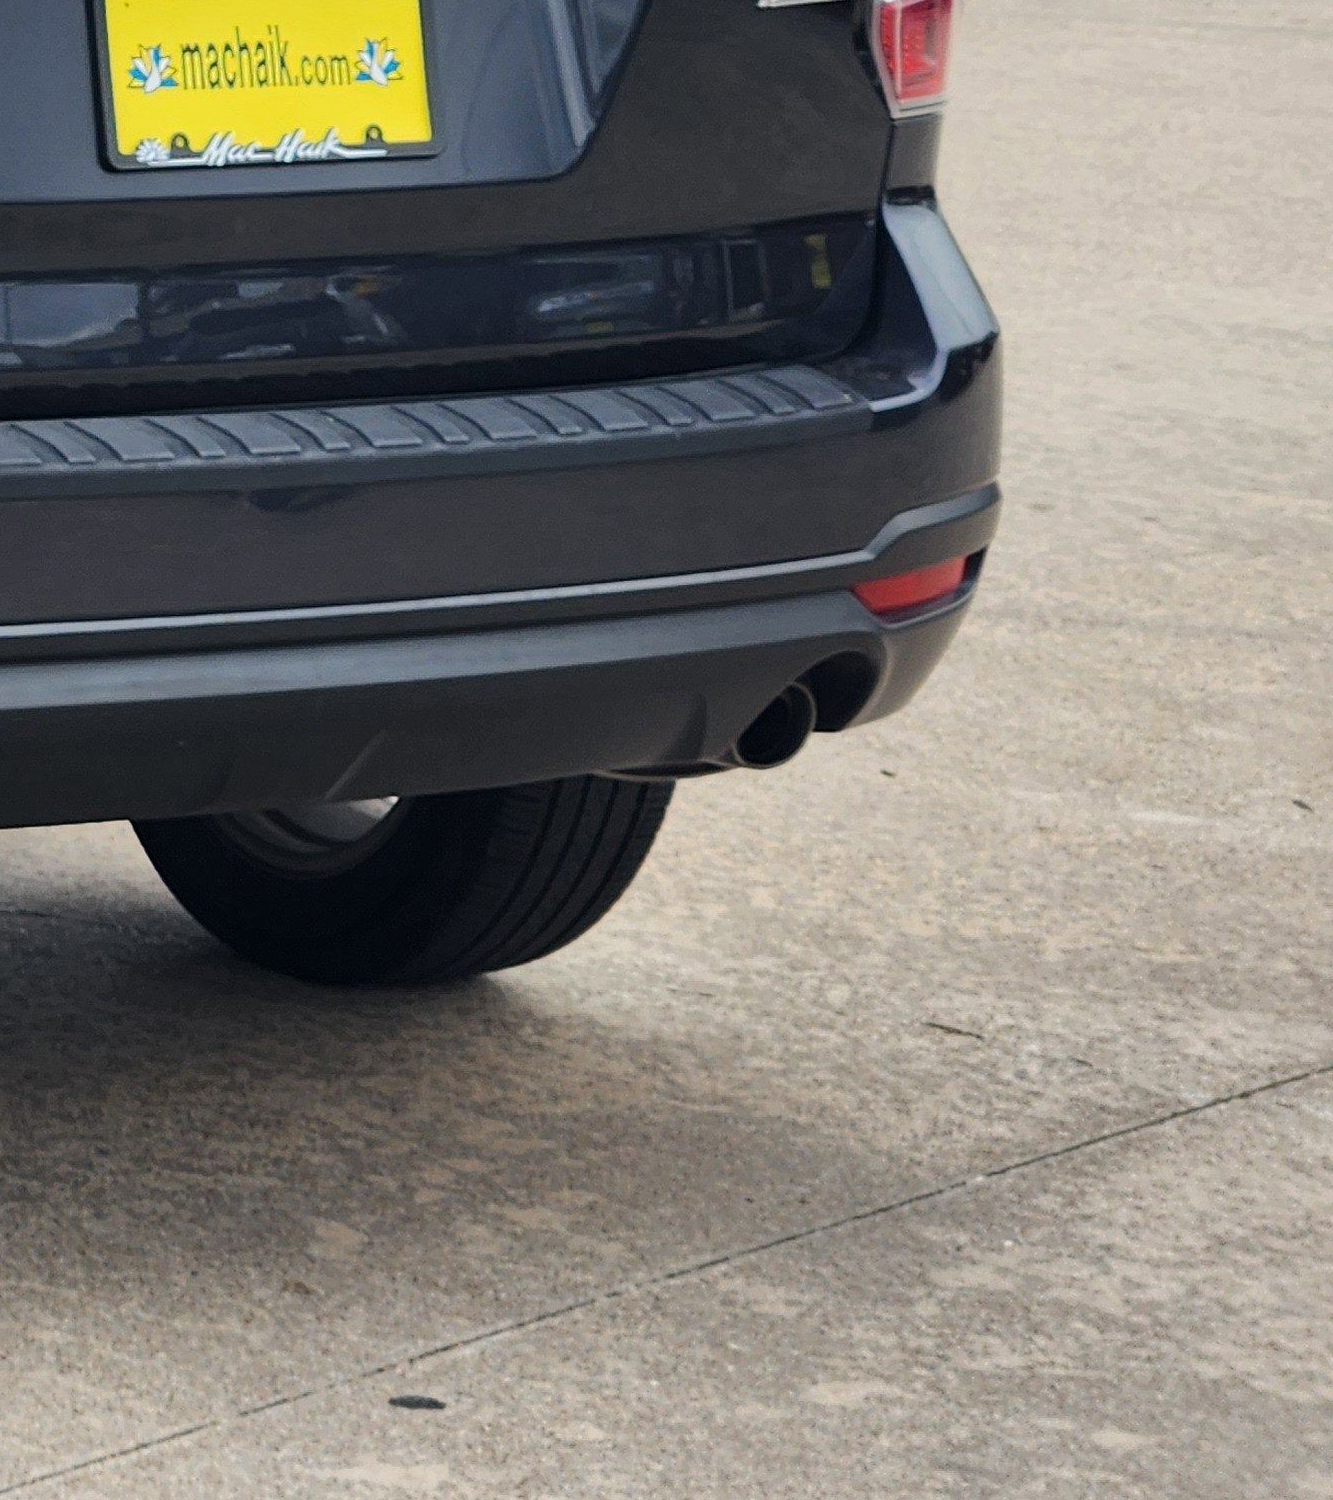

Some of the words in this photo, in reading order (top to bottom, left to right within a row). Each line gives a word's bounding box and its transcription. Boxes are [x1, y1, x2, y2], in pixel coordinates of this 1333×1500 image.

[180, 25, 353, 90] machaik.com
[201, 131, 267, 167] Mac
[274, 128, 347, 163] Haik
